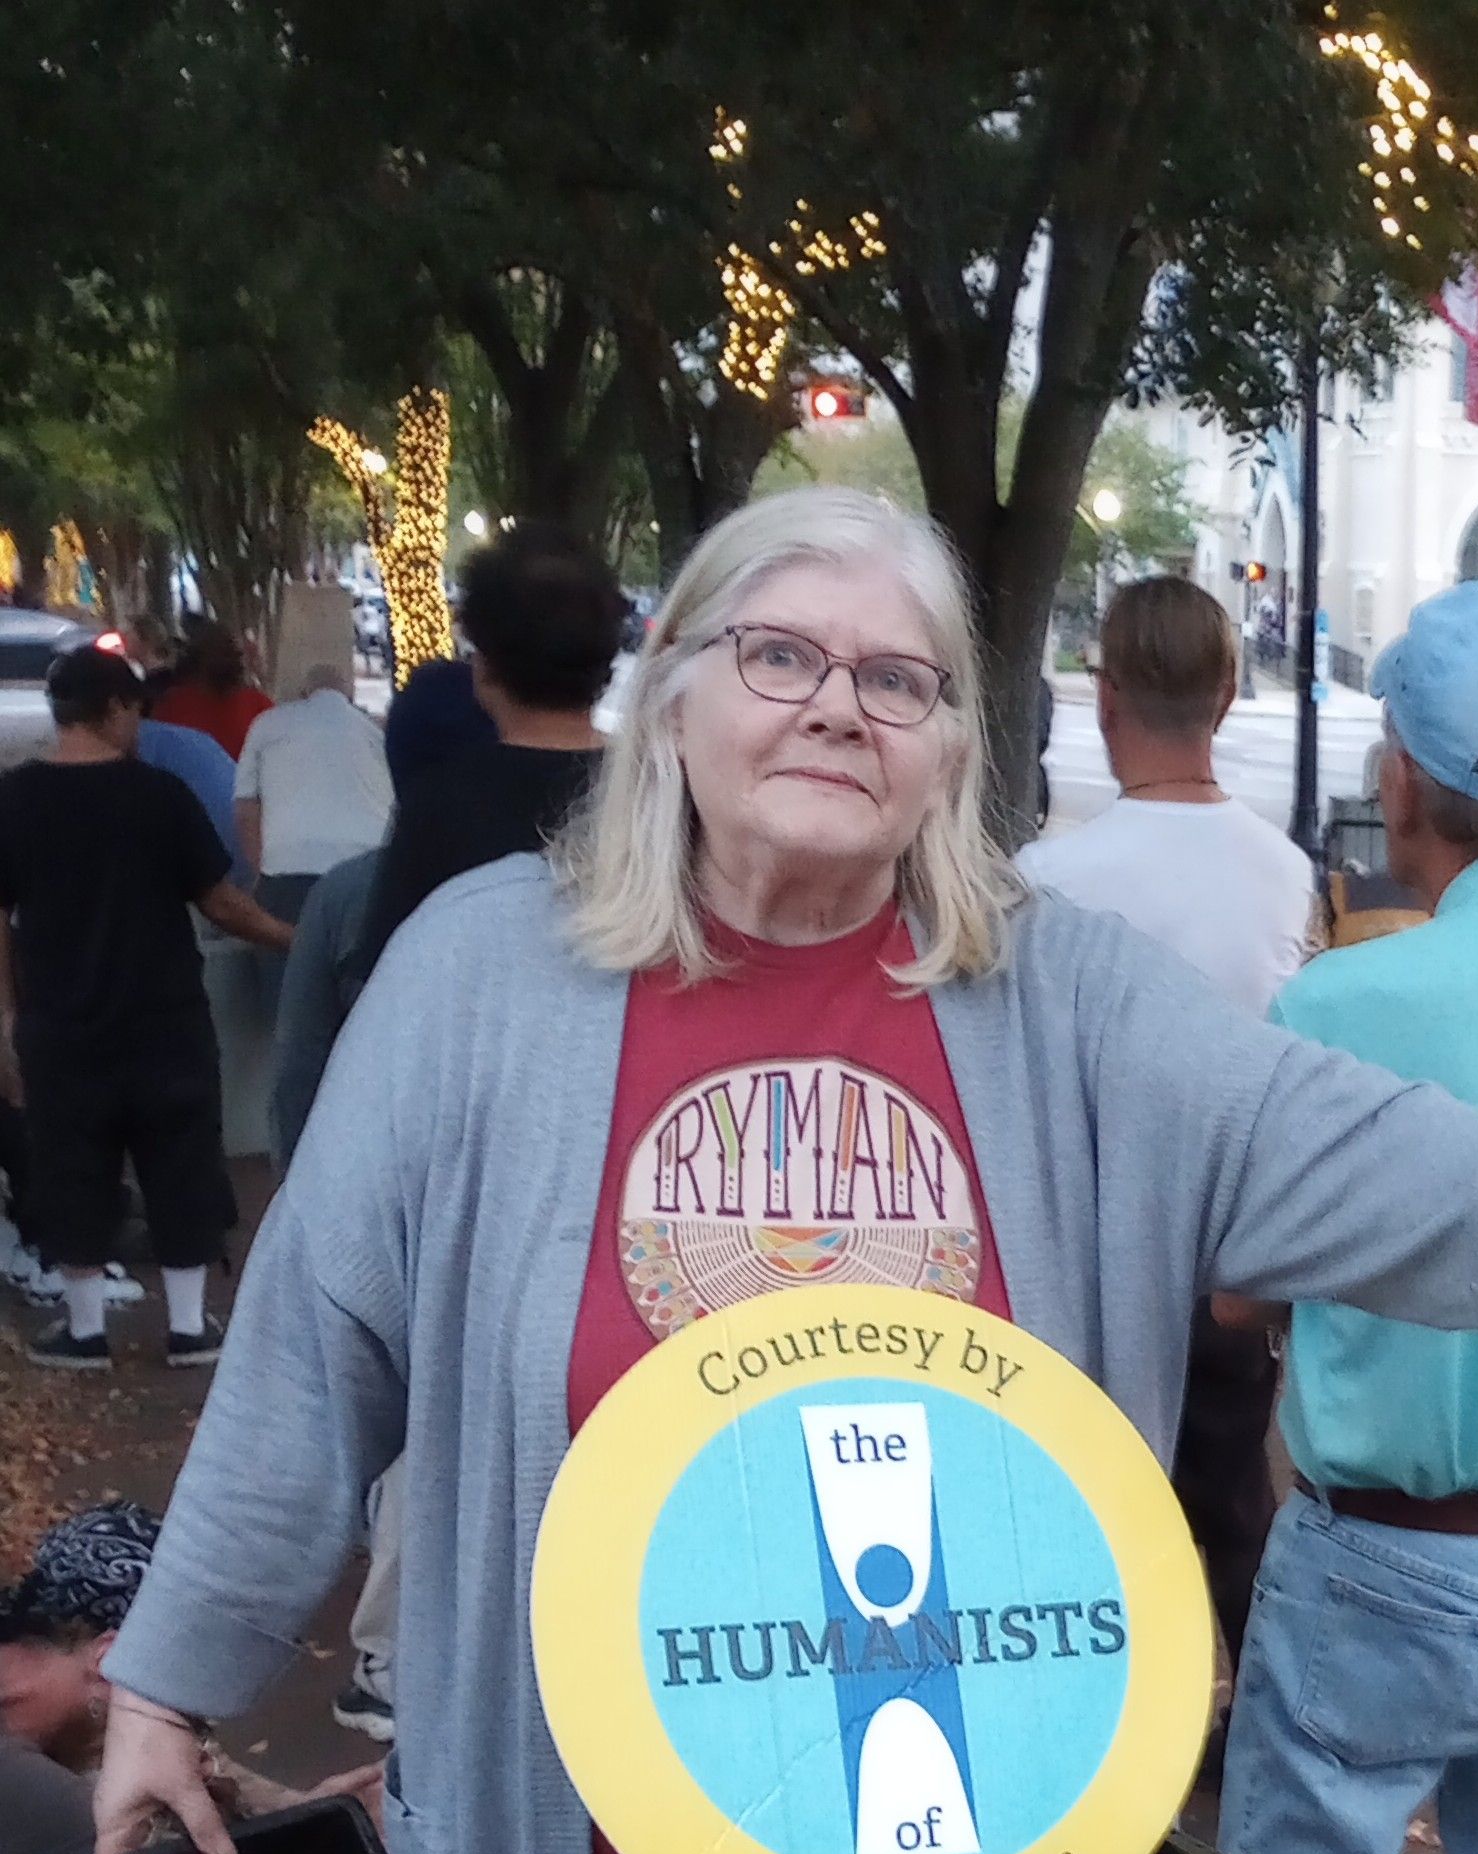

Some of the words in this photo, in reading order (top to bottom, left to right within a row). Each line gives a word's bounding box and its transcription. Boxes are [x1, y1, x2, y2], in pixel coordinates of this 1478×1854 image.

[652, 1068, 952, 1221] RYMAN
[697, 1316, 944, 1396] Courtesy
[959, 1335, 1026, 1398] by
[830, 1424, 907, 1465] the
[657, 1598, 1127, 1687] HUMANISTS
[895, 1808, 943, 1852] of
